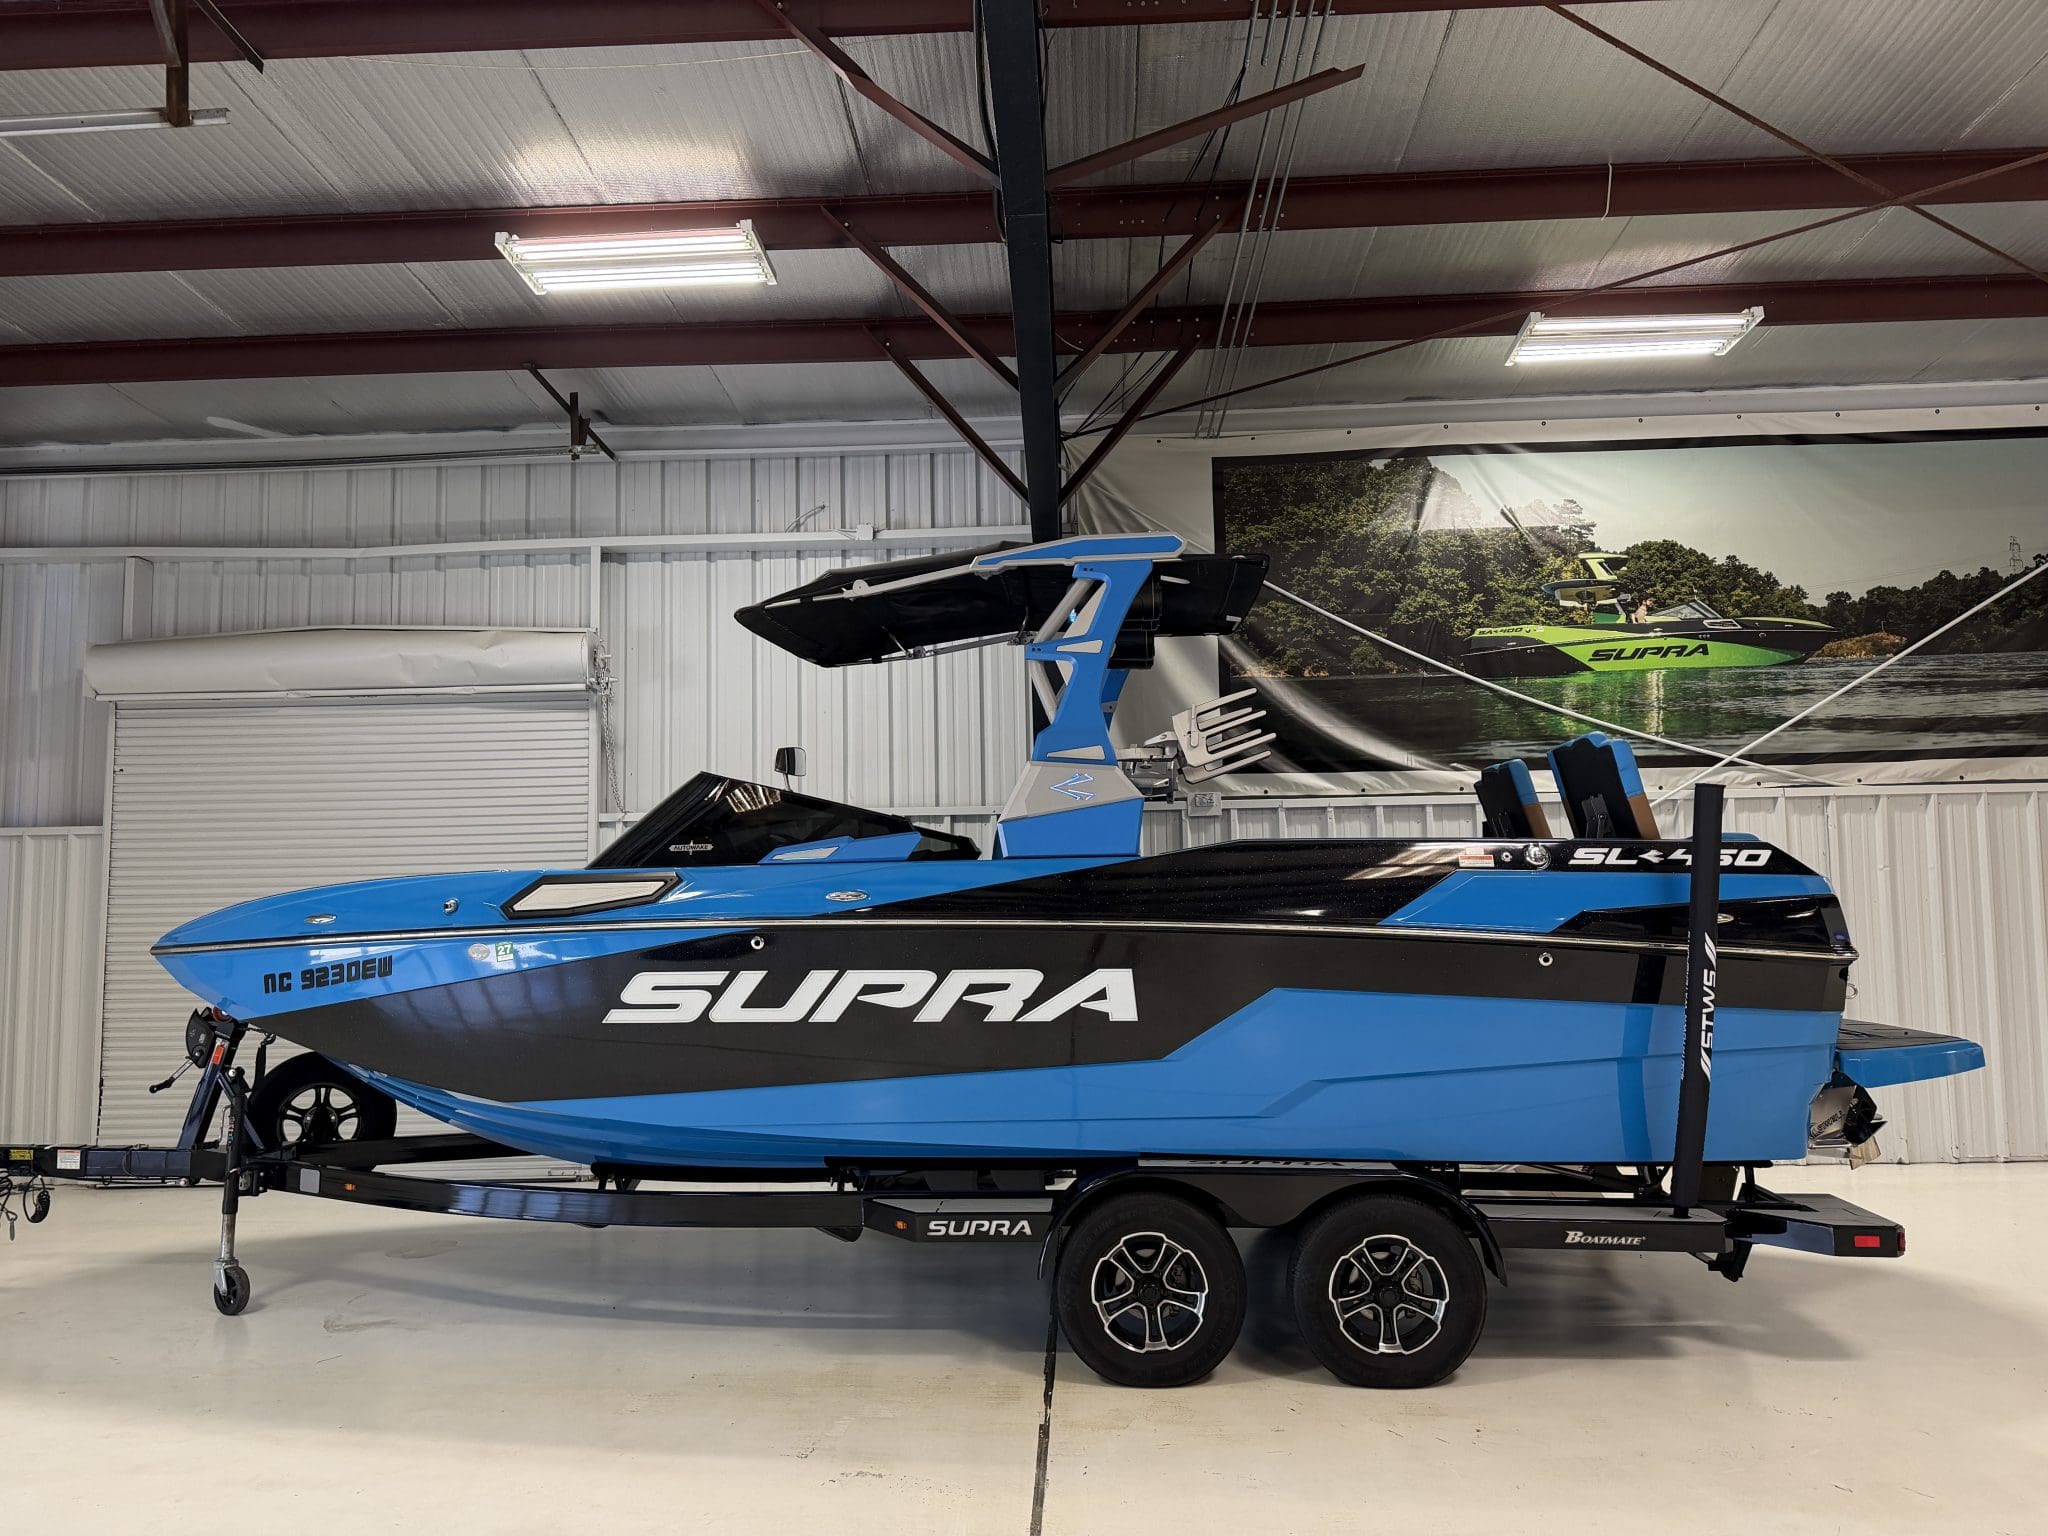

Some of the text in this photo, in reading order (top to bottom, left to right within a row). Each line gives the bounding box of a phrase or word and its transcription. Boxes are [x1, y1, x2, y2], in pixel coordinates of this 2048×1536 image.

[1588, 643, 1709, 661] SUPRA
[1568, 847, 1638, 865] SL
[497, 944, 512, 956] 27
[263, 971, 292, 994] NC
[602, 968, 1139, 1024] SUPRA
[1701, 968, 1717, 1049] STWS
[926, 1219, 1033, 1237] SUPRA
